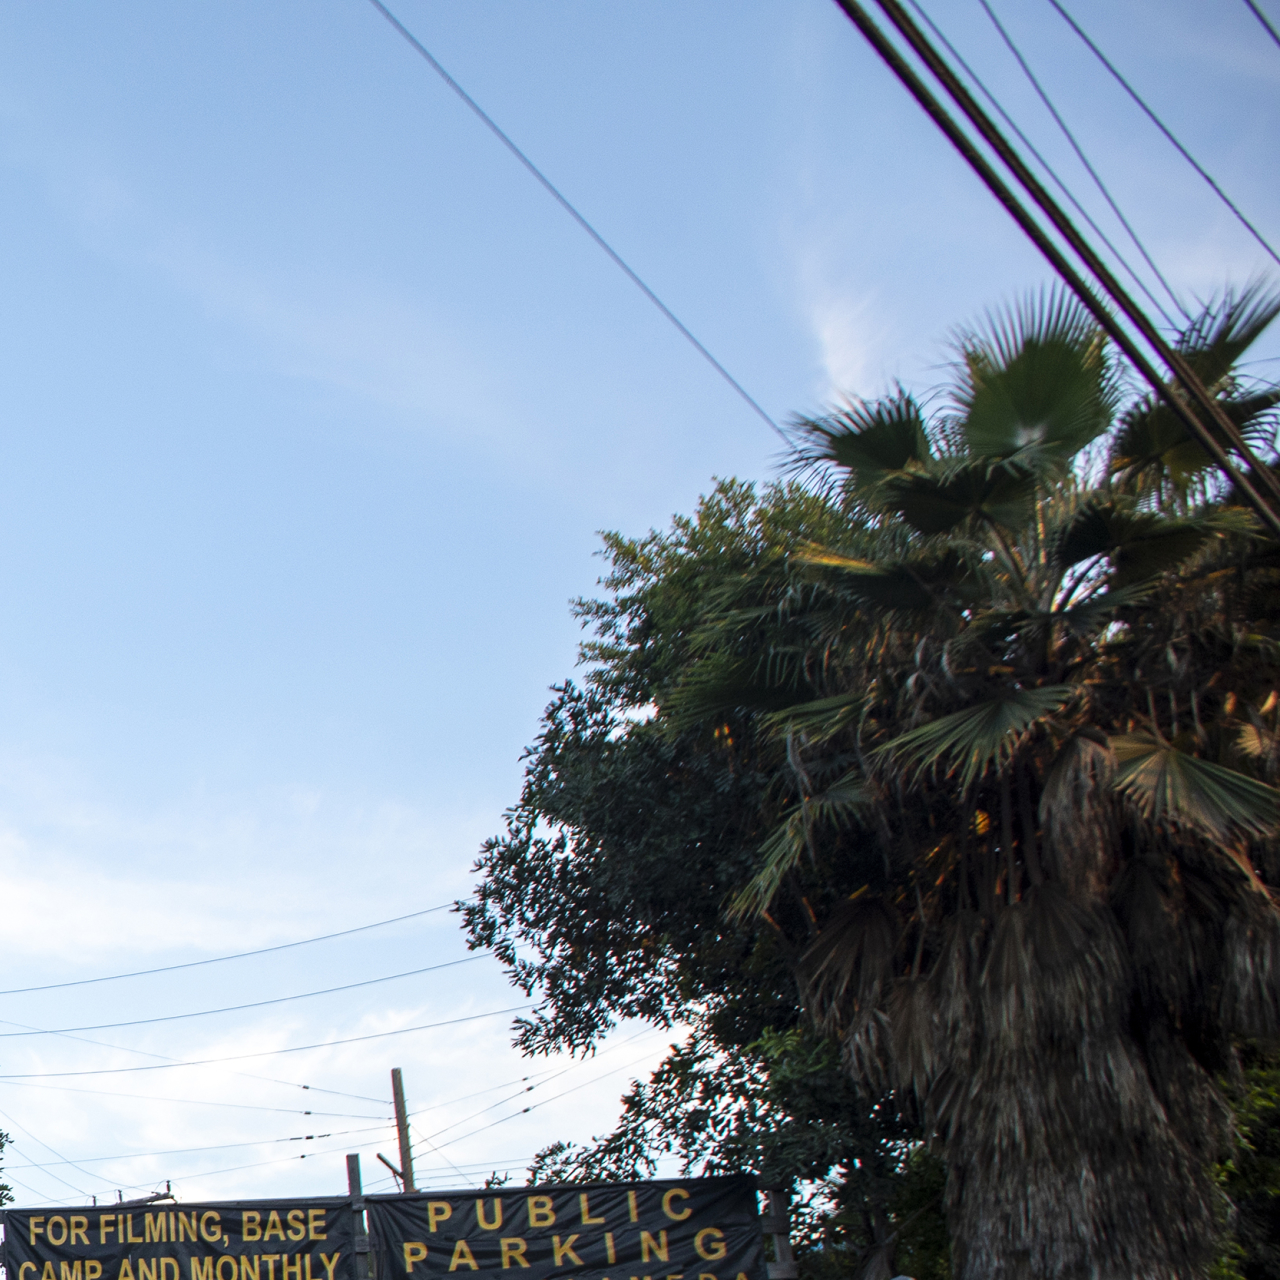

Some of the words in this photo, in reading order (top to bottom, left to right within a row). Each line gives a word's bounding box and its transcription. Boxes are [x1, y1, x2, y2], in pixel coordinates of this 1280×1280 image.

[29, 1215, 90, 1246] FOR
[100, 1211, 230, 1248] FILMING,
[242, 1208, 328, 1242] BASE
[427, 1188, 693, 1233] PUBLIC
[403, 1227, 727, 1273] PARKING
